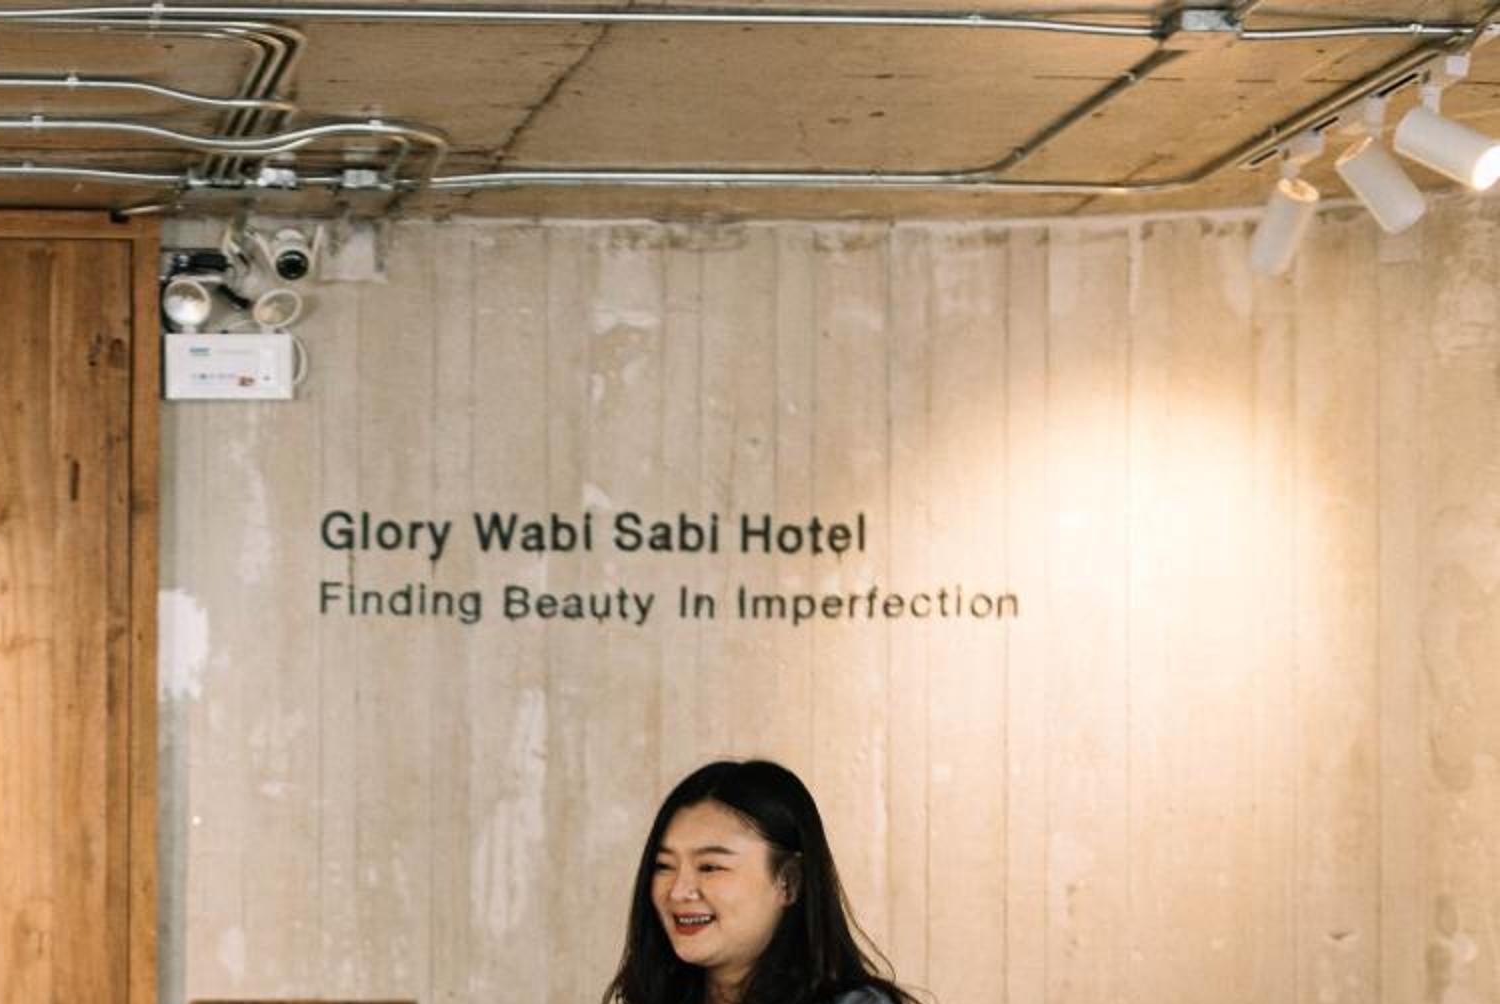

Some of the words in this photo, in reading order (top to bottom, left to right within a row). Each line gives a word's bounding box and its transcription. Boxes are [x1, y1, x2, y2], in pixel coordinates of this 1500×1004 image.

[320, 510, 452, 562] Glory
[473, 511, 592, 552] Wabi
[614, 511, 719, 553] Sabi
[741, 512, 866, 556] Hotel
[319, 580, 483, 625] Finding
[503, 584, 656, 626] Beauty
[679, 584, 716, 620] In
[737, 584, 1019, 627] Imperfection
